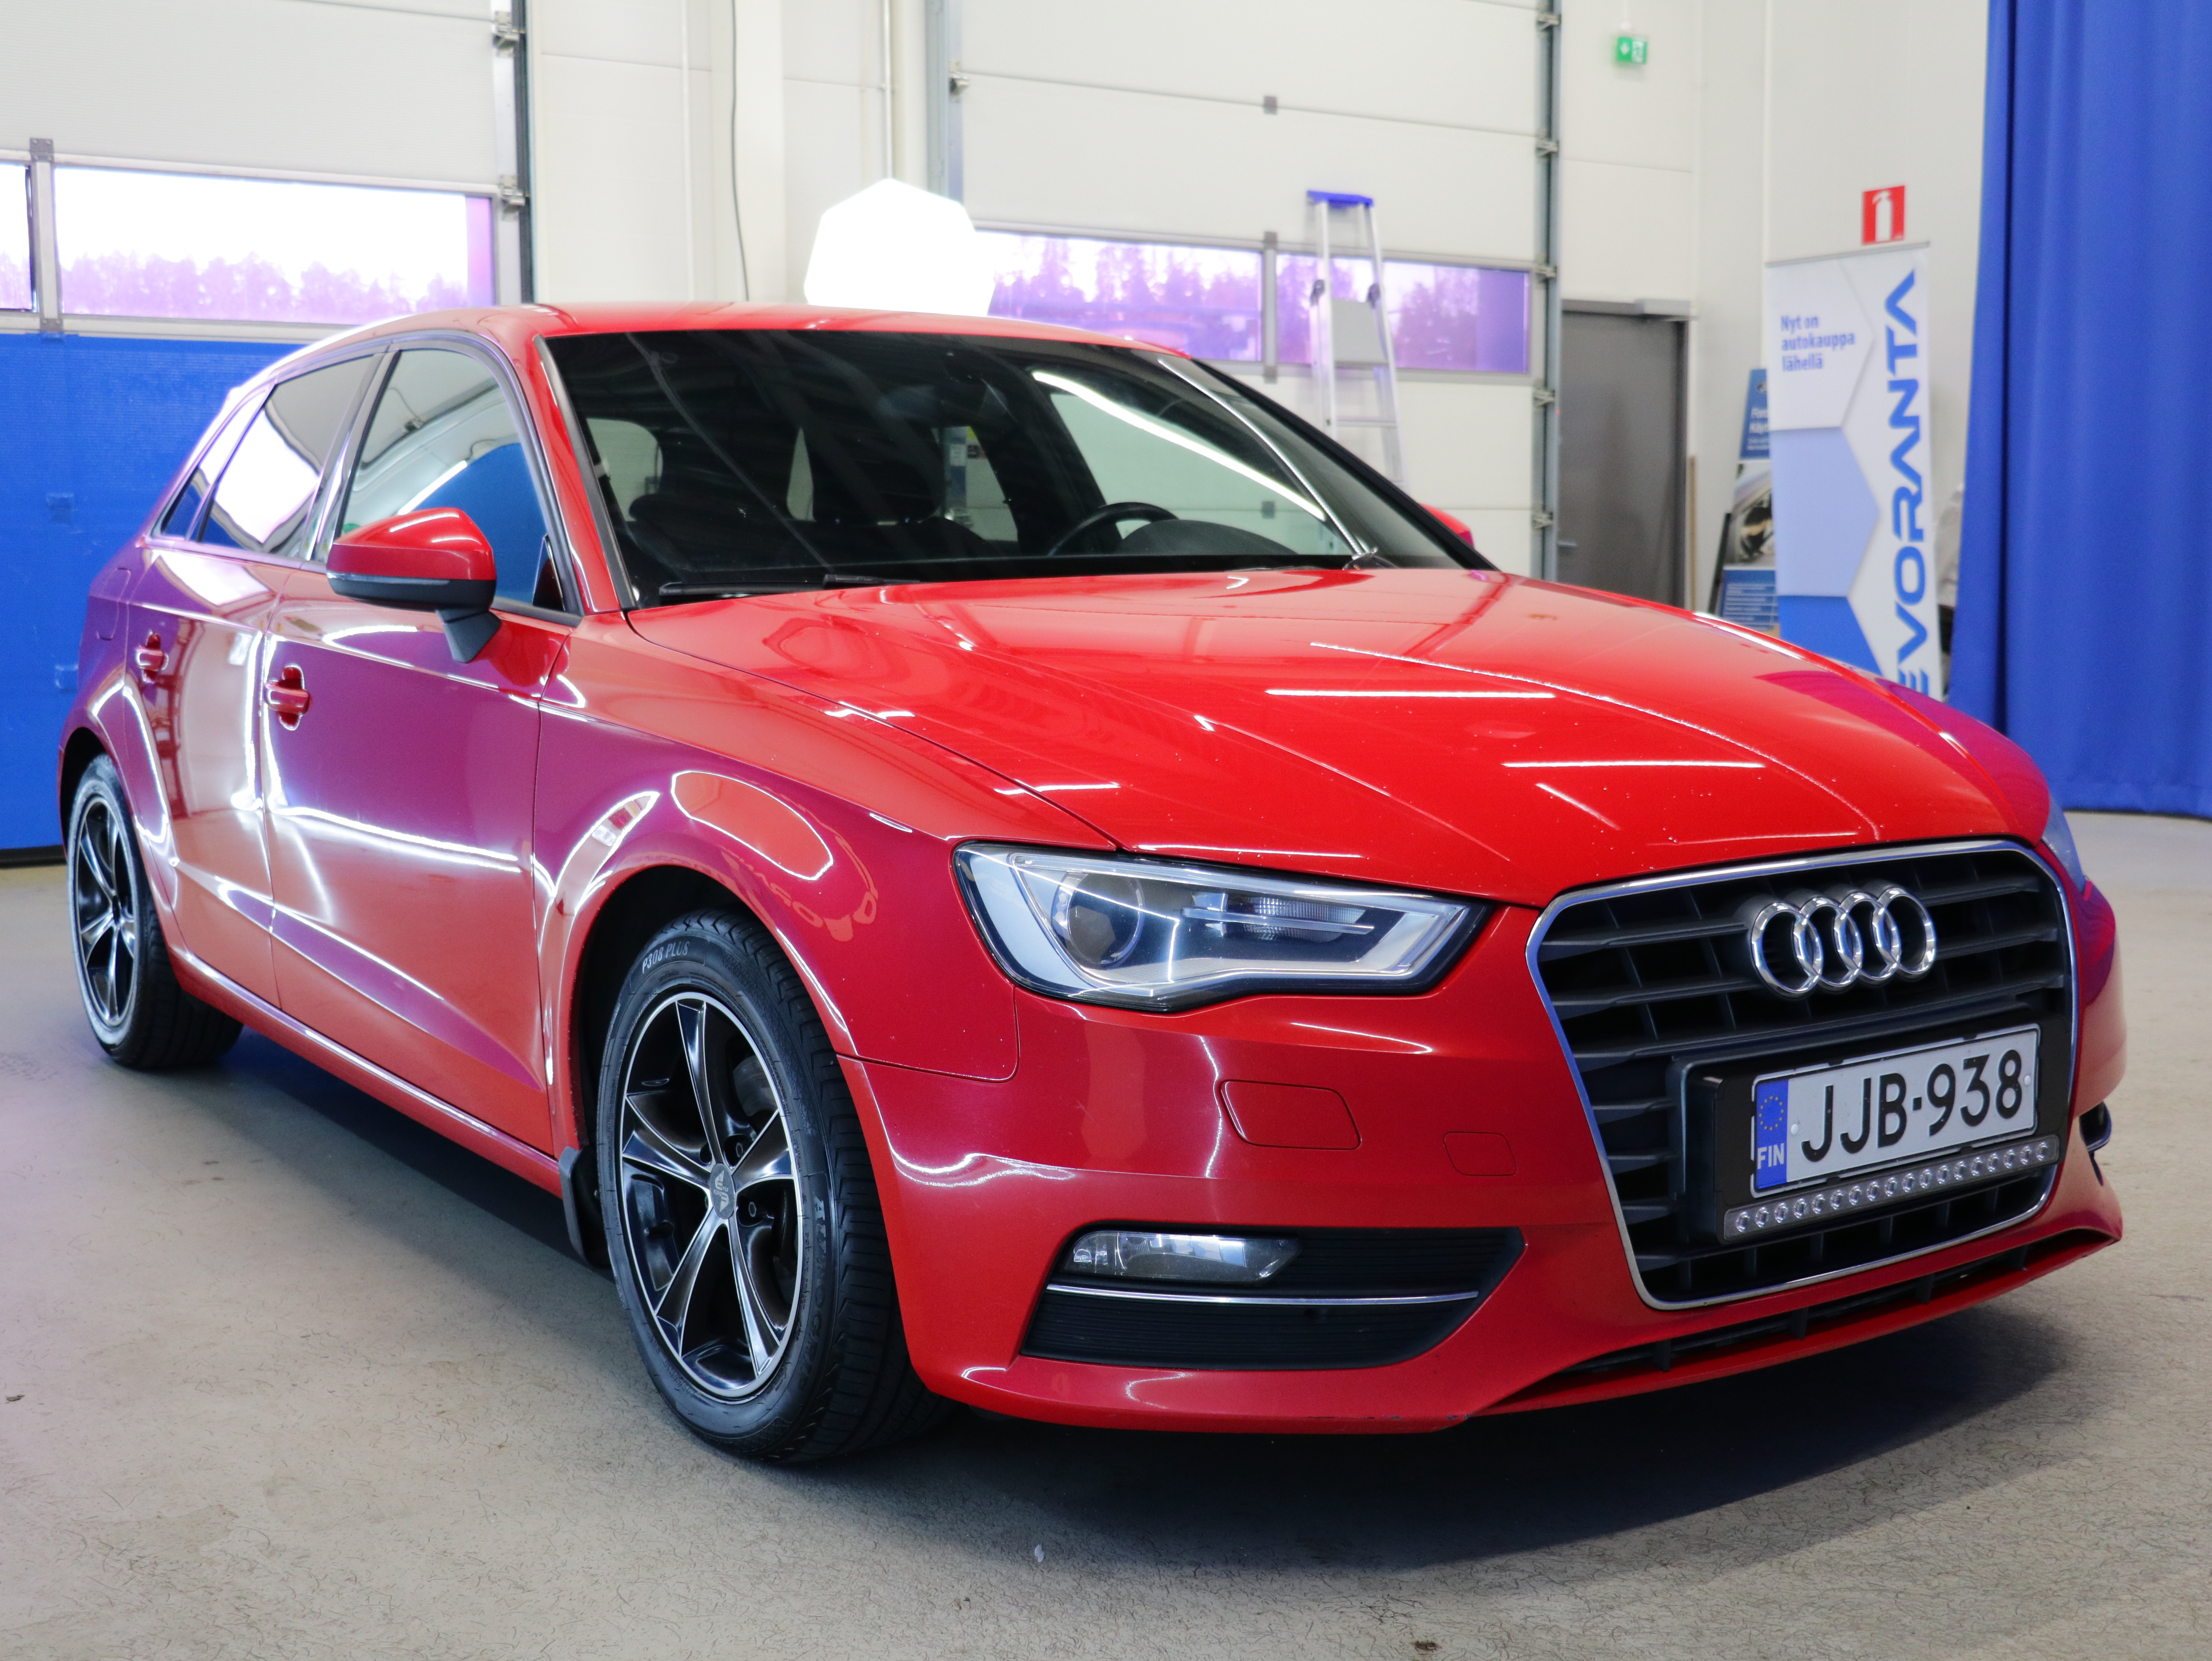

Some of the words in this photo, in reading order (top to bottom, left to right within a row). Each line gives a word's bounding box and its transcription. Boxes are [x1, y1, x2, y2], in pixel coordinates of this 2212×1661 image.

[1781, 316, 1802, 334] Nyt
[1805, 317, 1819, 328] on
[1782, 333, 1855, 351] autokauppa
[1782, 353, 1824, 372] lähellä
[642, 946, 664, 974] P308
[666, 941, 690, 958] PLUS
[1801, 1049, 2022, 1162] JJB-938
[1757, 1143, 1784, 1170] FIN
